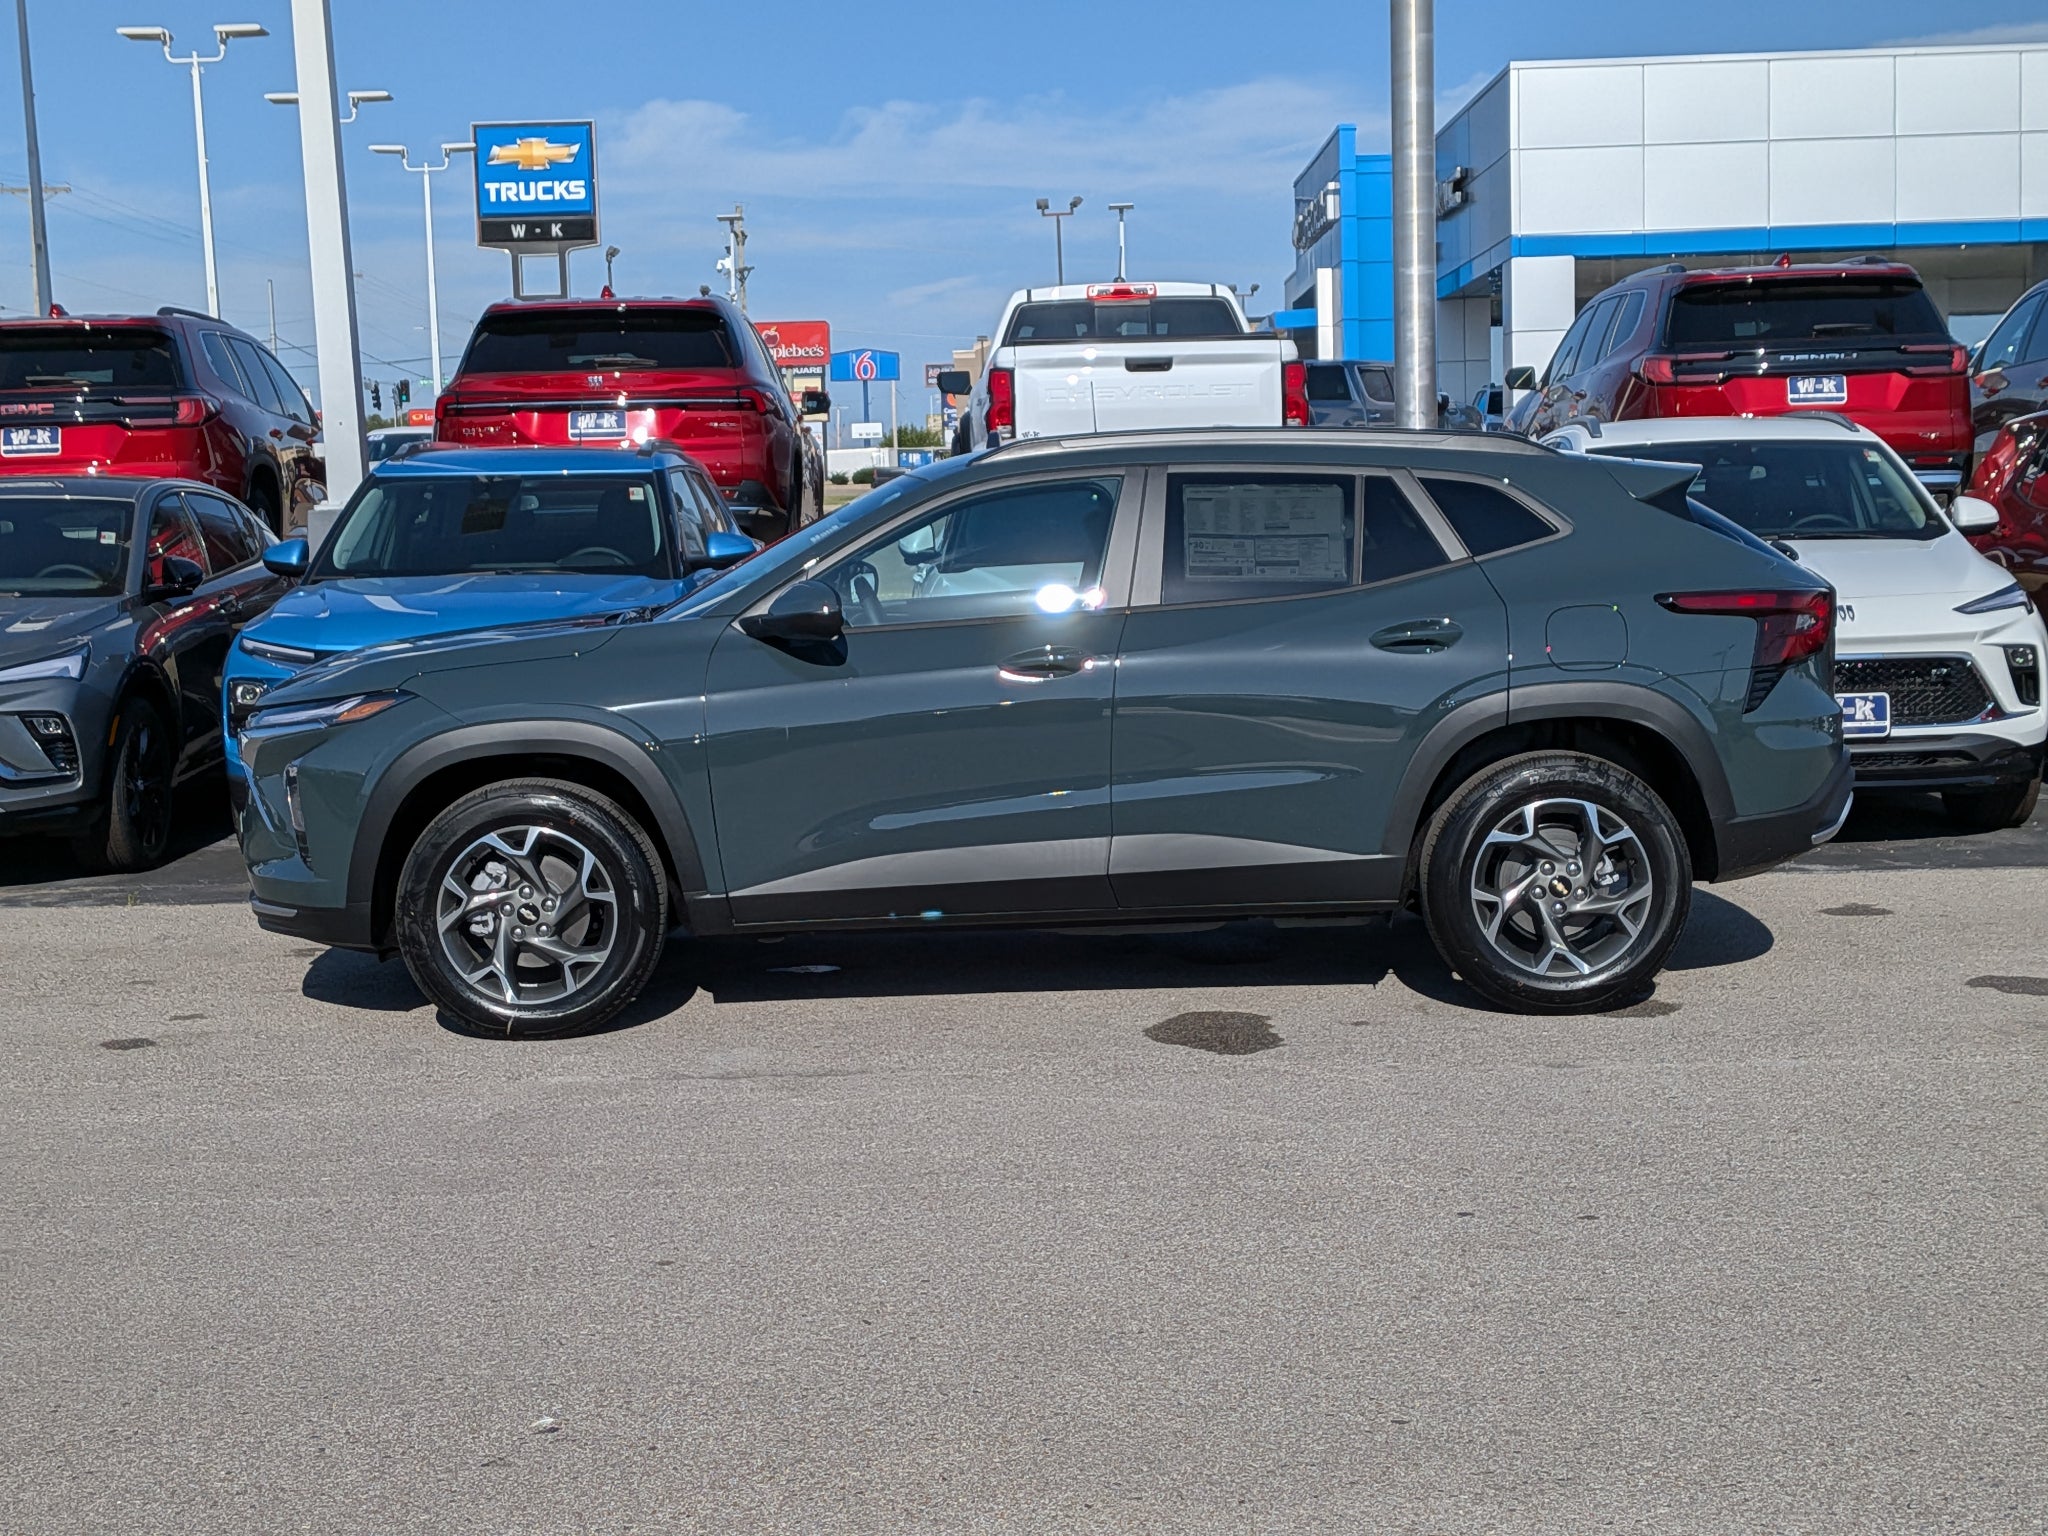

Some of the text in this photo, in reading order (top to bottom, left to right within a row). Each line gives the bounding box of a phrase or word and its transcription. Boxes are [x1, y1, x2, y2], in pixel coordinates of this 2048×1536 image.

[484, 180, 586, 202] TRUCKS
[511, 224, 526, 238] W
[551, 223, 563, 237] K
[769, 343, 825, 361] plebee's
[855, 351, 876, 380] 6
[1046, 383, 1253, 401] CHEVROLET
[1797, 377, 1837, 393] W-K
[0, 403, 54, 415] GMC
[578, 412, 618, 428] W-K
[10, 428, 51, 445] W-K
[1836, 697, 1876, 721] -K
